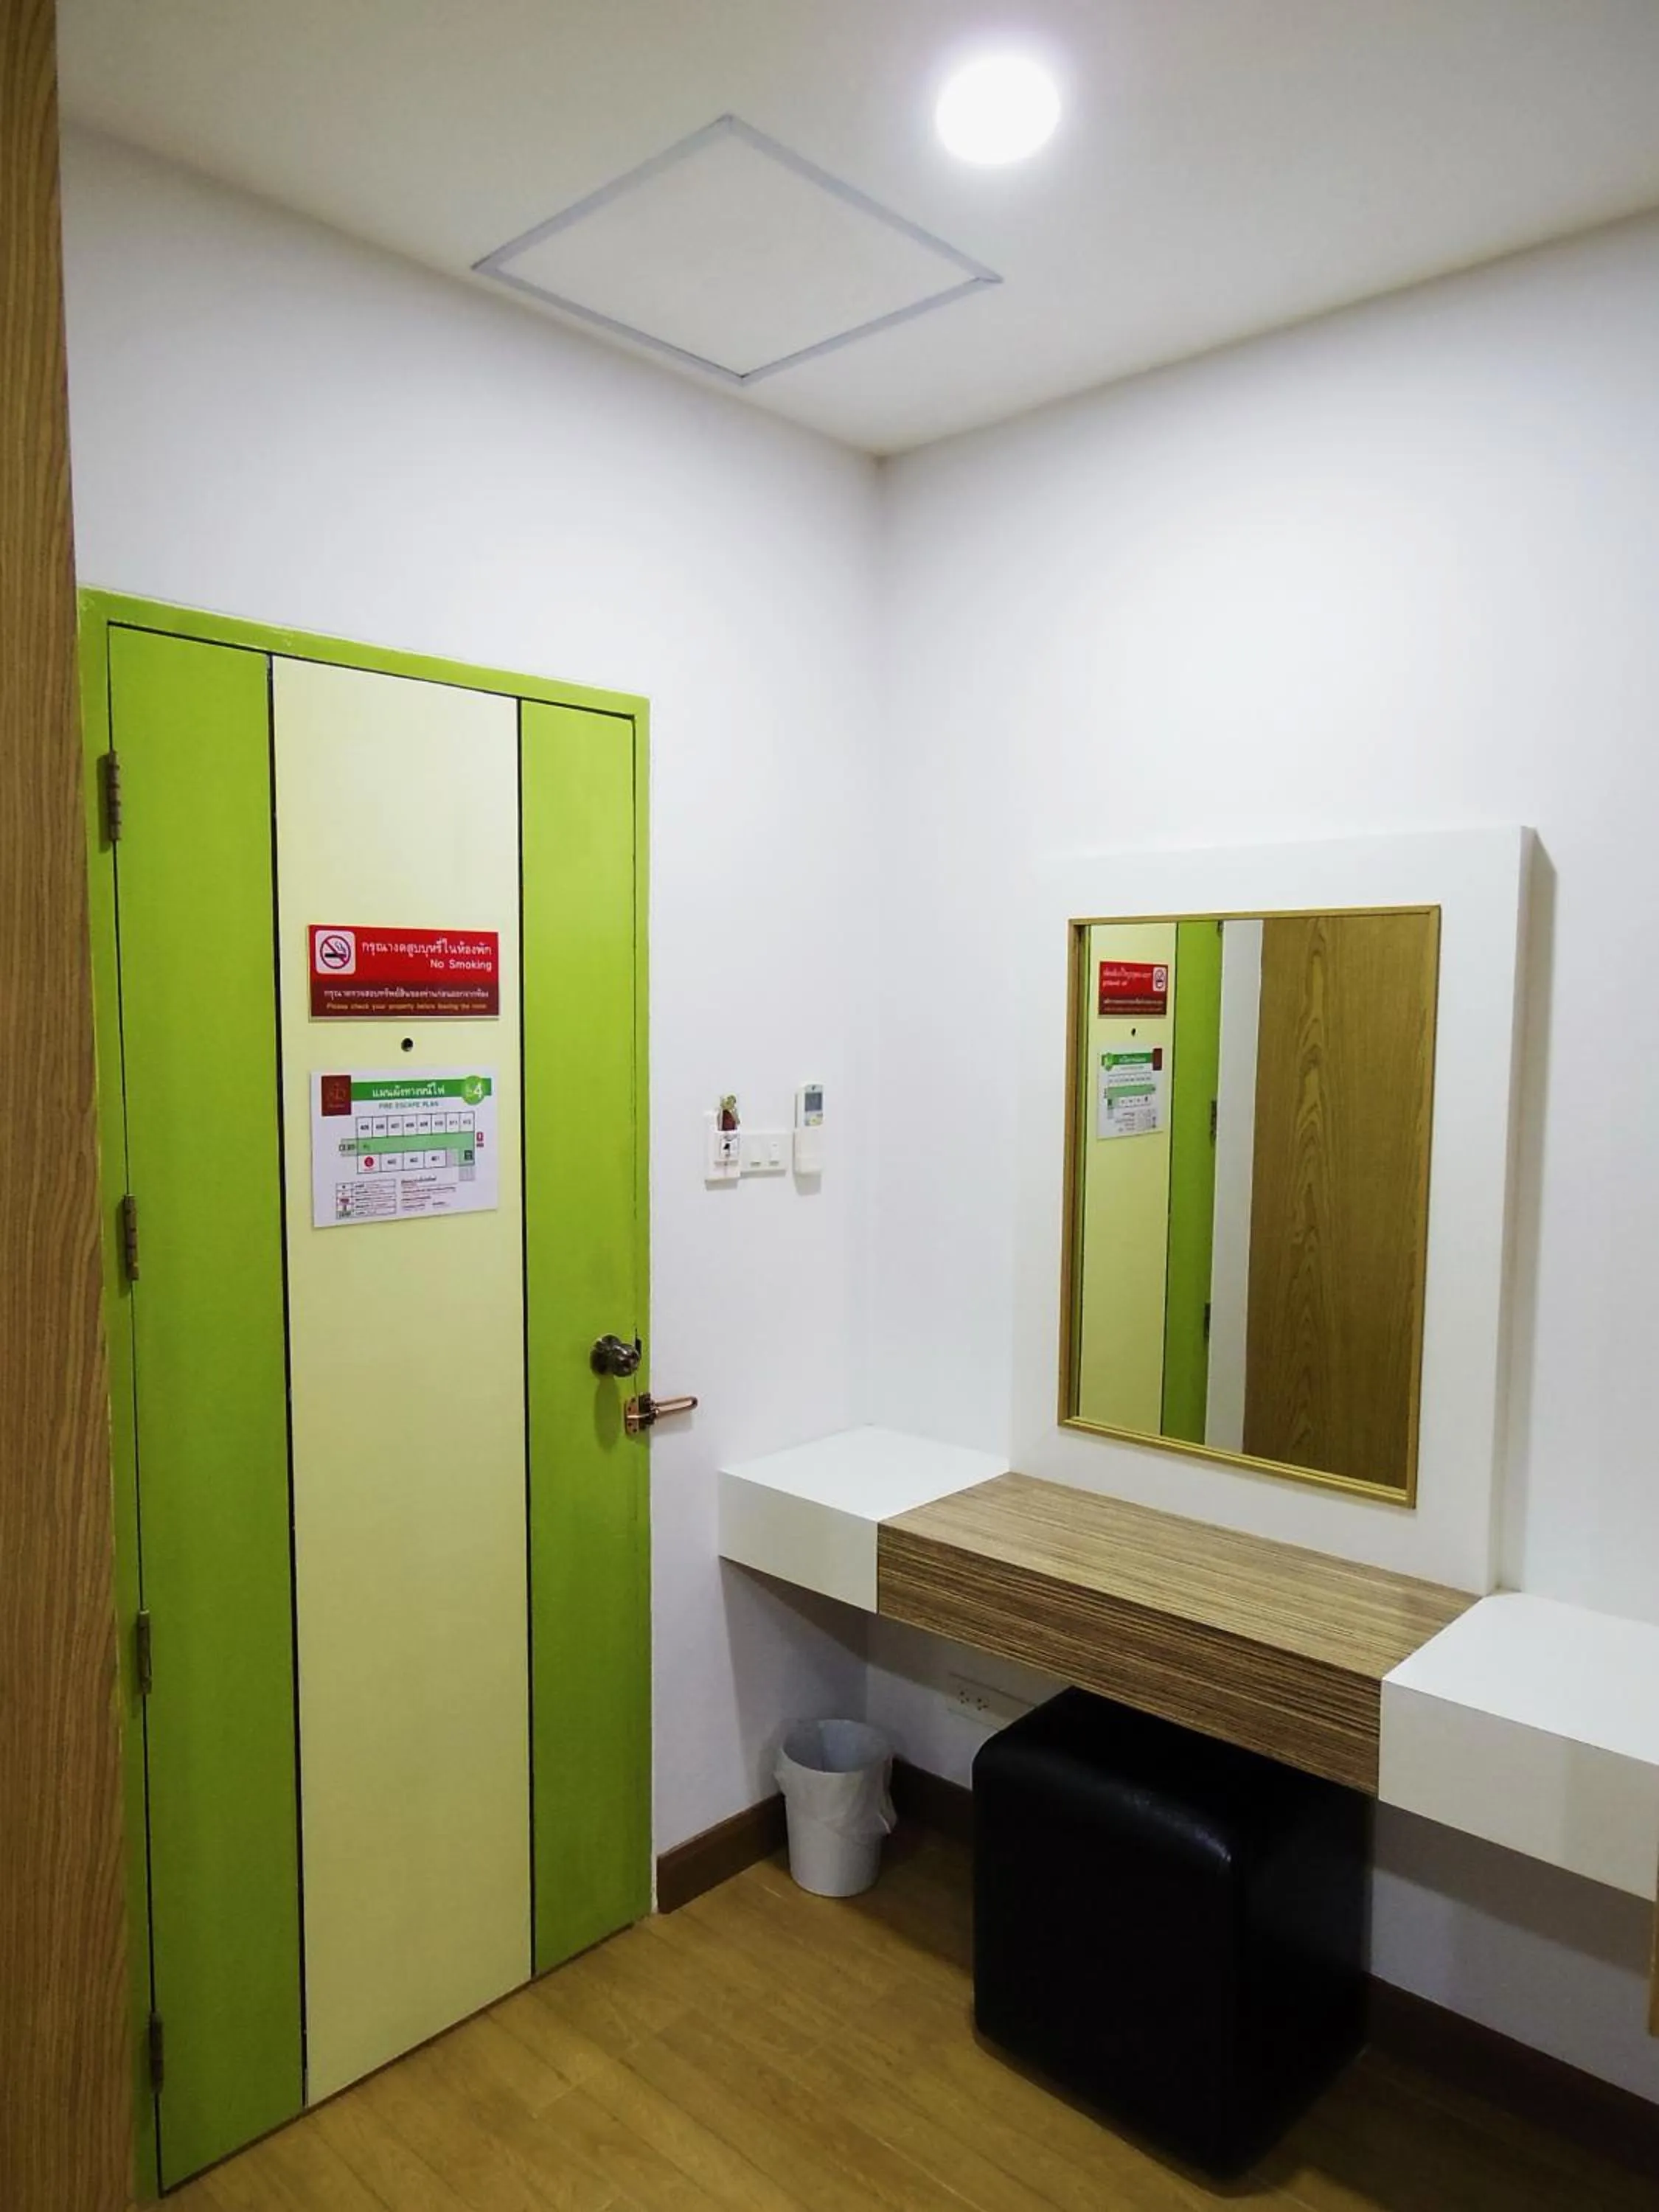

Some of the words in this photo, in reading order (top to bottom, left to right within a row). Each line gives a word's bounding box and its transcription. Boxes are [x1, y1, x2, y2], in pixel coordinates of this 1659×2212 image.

[431, 959, 444, 969] No
[449, 959, 492, 971] Smoking
[474, 1082, 483, 1098] 4
